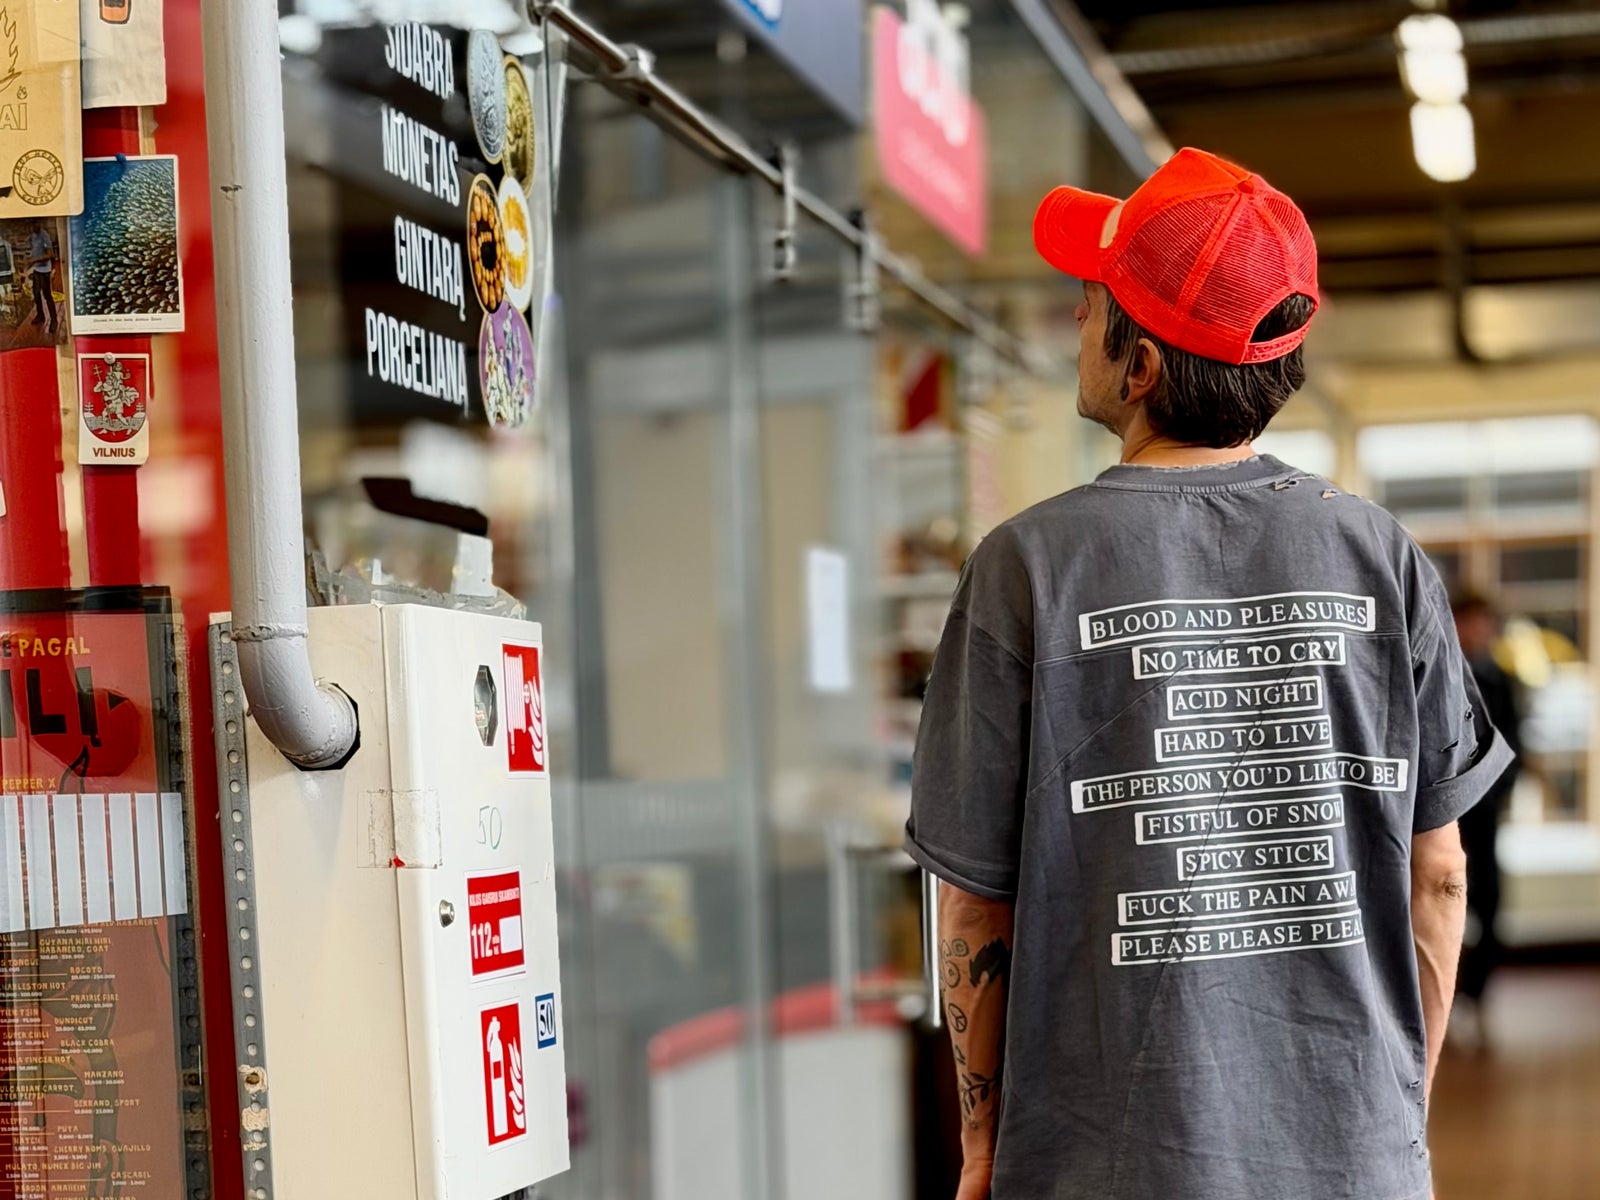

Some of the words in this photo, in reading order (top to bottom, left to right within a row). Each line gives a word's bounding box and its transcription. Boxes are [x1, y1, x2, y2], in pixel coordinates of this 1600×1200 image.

[381, 104, 460, 207] MONETAS
[394, 215, 466, 322] GINTARĄ
[92, 447, 136, 458] VILNIUS
[1092, 610, 1177, 640] BLOOD
[1184, 609, 1232, 628] AND
[1240, 601, 1367, 626] PLEASURES
[18, 636, 91, 657] PAGAL
[1142, 651, 1176, 673] NO
[1183, 648, 1240, 669] TIME
[1247, 645, 1281, 665] TO
[1290, 640, 1337, 661] CRY
[1175, 690, 1227, 711] ACID
[1235, 682, 1316, 707] NIGHT
[1164, 731, 1225, 753] HARD
[1232, 728, 1265, 747] TO
[1275, 721, 1329, 744] LIVE
[2, 777, 43, 790] PEPPER
[48, 777, 56, 789] X
[1083, 782, 1125, 803] THE
[1130, 771, 1211, 797] PERSON
[1217, 765, 1292, 788] YOU'D
[1338, 761, 1365, 780] TO
[1372, 765, 1395, 785] BE
[476, 805, 502, 849] 50
[1148, 810, 1239, 836] FISTFUL
[1246, 807, 1279, 827] OF
[1186, 850, 1245, 873] SPICY
[1255, 843, 1329, 866] STICK
[1127, 895, 1194, 917] FUCK
[1201, 891, 1241, 912] THE
[1248, 885, 1307, 907] PAIN
[471, 921, 493, 960] 112
[1121, 934, 1212, 957] PLEASE
[1218, 925, 1302, 950] PLEASE
[70, 966, 103, 974] ROCOTO
[540, 1002, 553, 1037] 50
[60, 1039, 86, 1047] BLACK
[88, 1038, 114, 1047] COBRA
[84, 1070, 124, 1078] MANZANO
[57, 1125, 79, 1133] PUYA
[111, 1171, 152, 1179] CASCABEL
